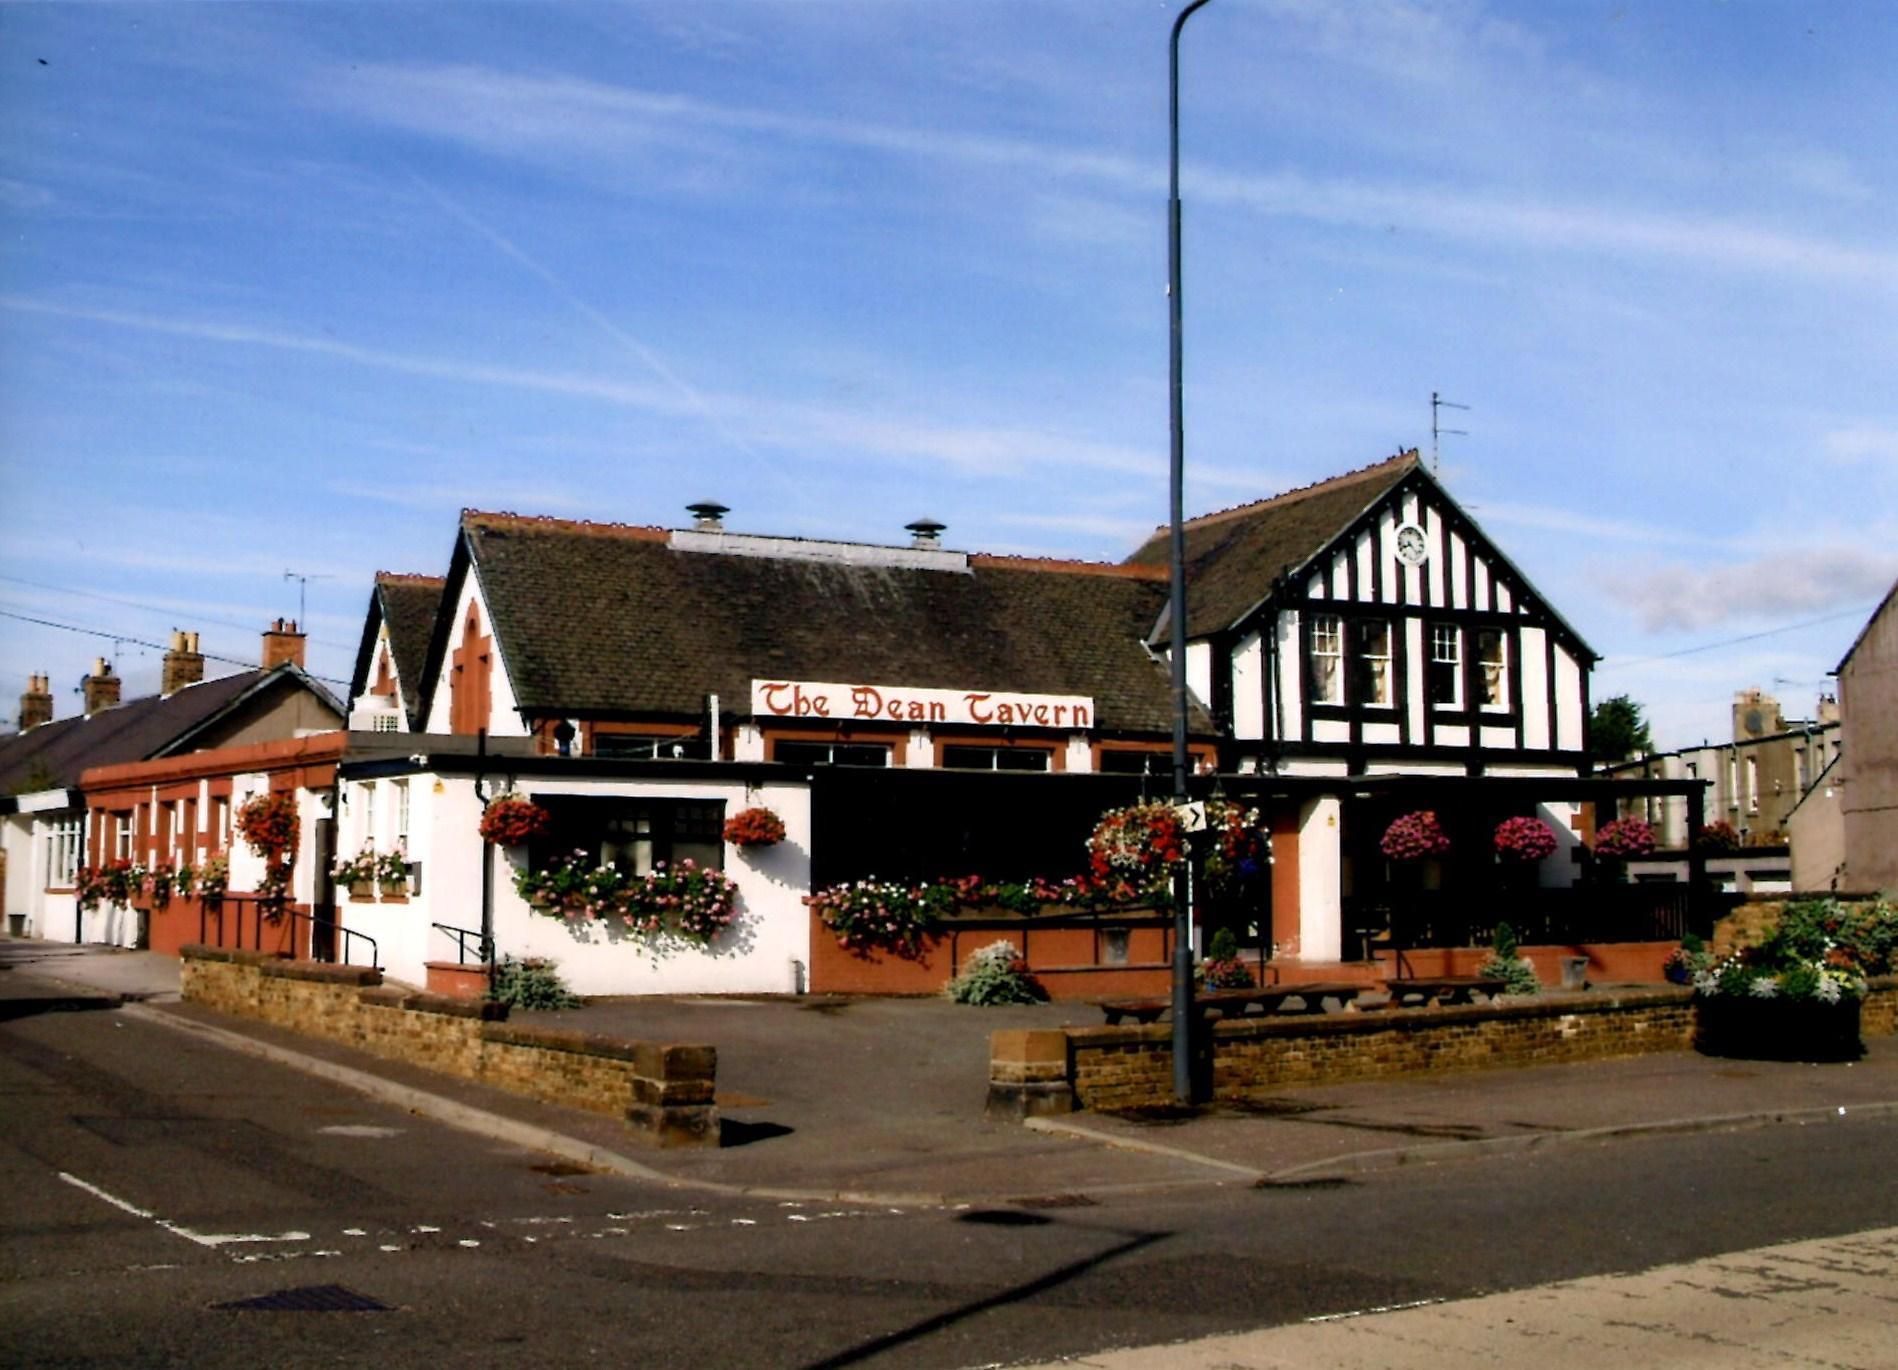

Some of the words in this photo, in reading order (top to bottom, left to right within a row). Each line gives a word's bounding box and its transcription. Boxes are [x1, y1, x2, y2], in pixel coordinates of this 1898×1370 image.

[759, 683, 830, 717] The
[851, 686, 946, 721] Dean
[963, 693, 1089, 726] Tavern
